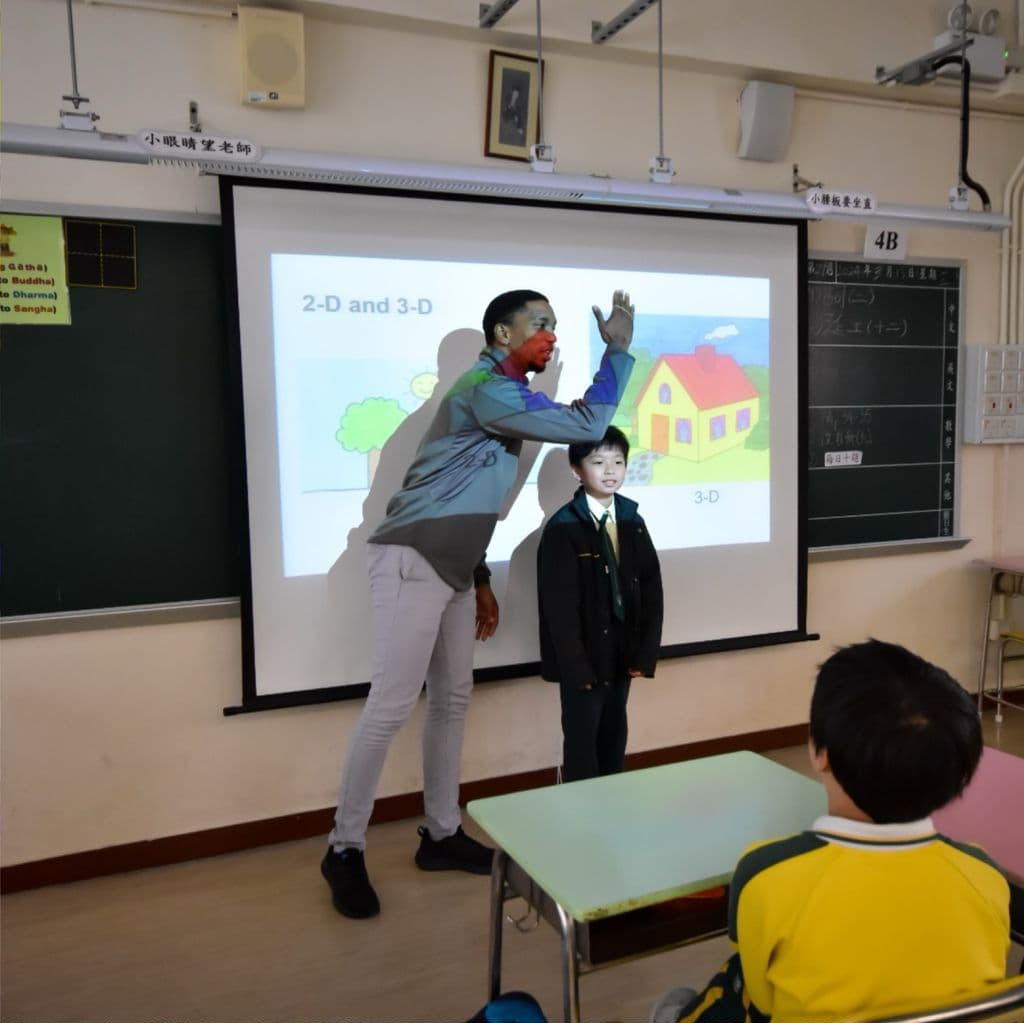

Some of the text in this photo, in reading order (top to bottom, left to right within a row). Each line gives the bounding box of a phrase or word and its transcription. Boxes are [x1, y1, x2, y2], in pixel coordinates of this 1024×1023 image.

[874, 230, 899, 251] 4B
[11, 276, 55, 287] Buddha)
[12, 290, 57, 301] Dharma)
[14, 304, 57, 315] Sangha)
[302, 294, 433, 315] 2-D and 3-D
[694, 489, 720, 505] 3-D
